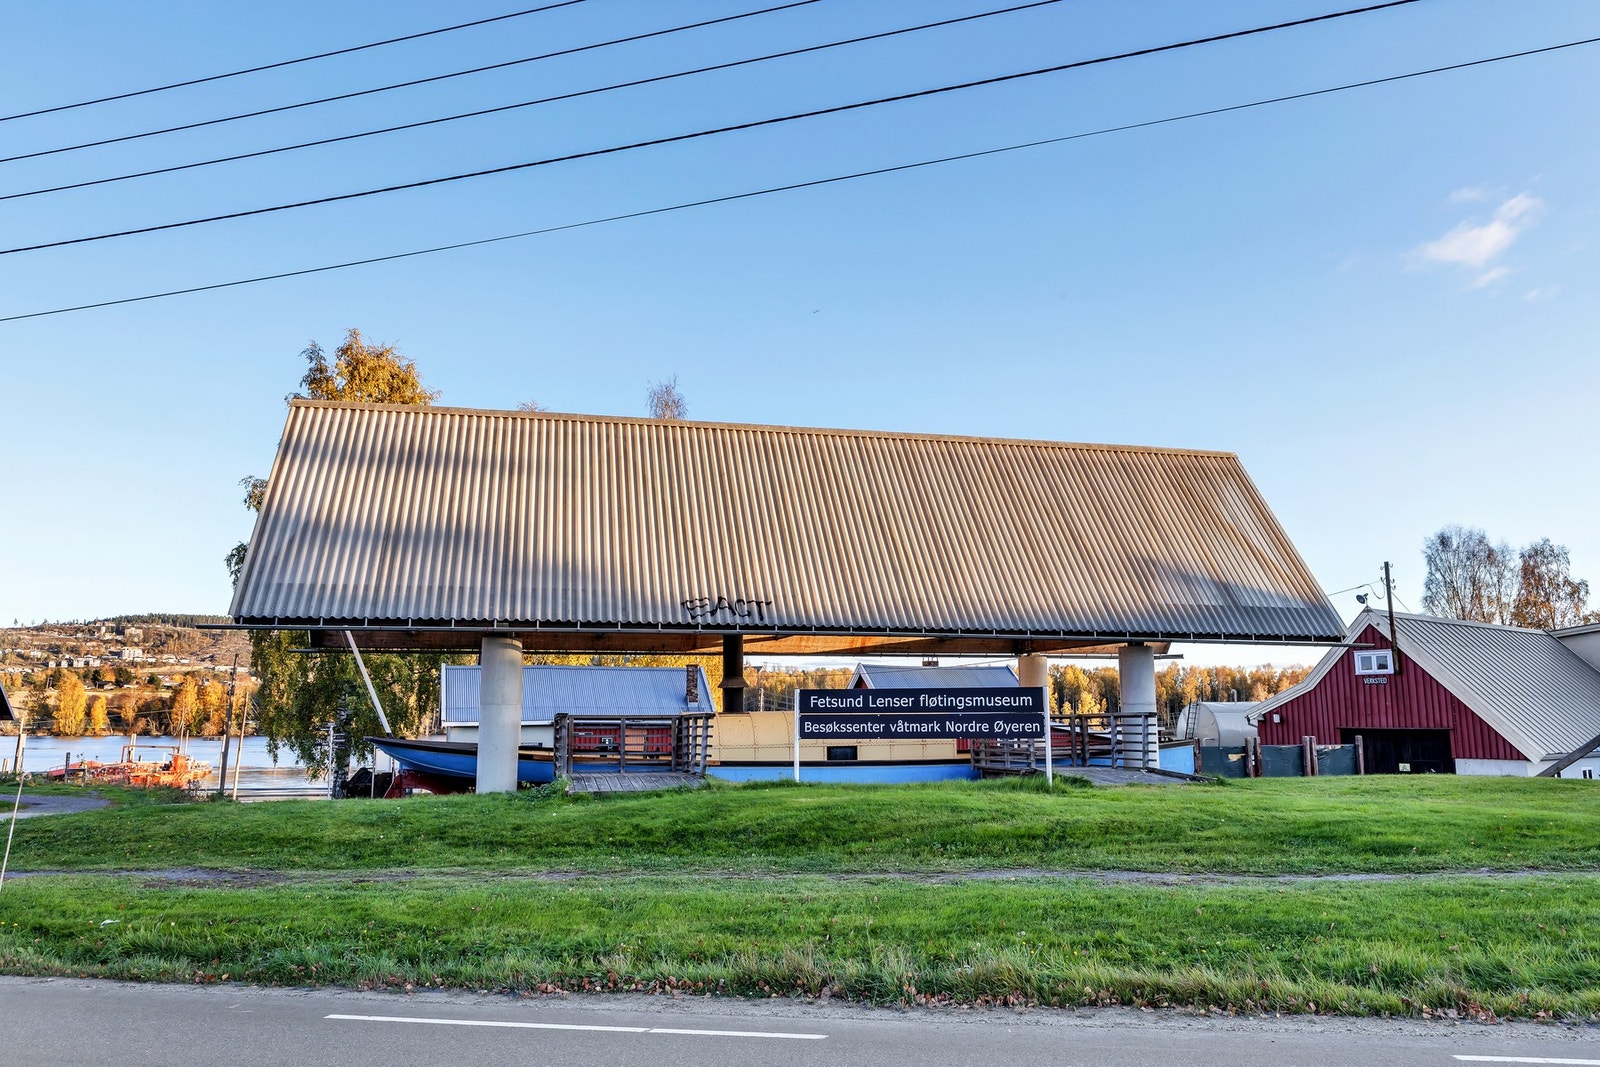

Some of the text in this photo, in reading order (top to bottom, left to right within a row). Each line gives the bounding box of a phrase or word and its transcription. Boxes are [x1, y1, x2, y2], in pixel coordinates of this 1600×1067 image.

[810, 694, 1033, 710] Fetsund Lenser fløtingsmuseum
[804, 719, 1041, 735] Besøkssenter våtmark Nordre Øyeren
